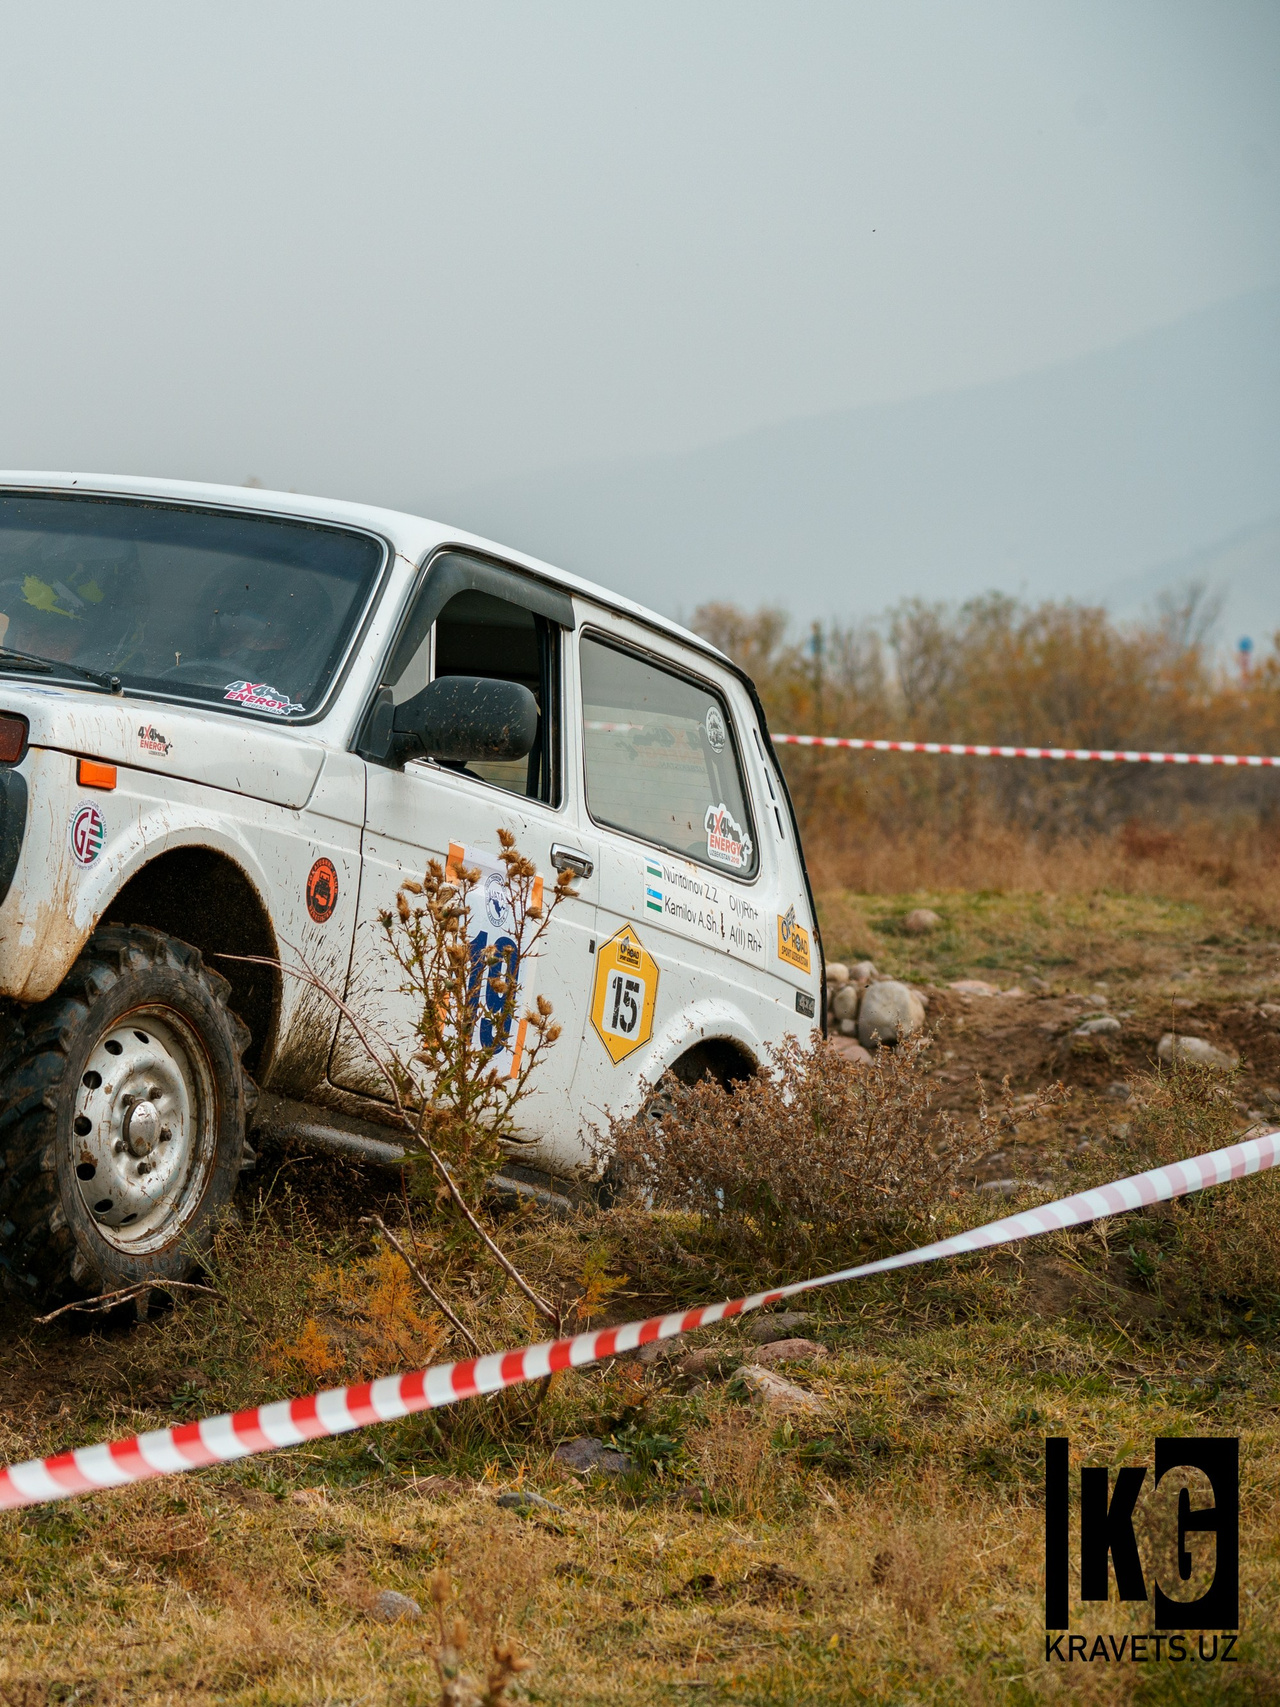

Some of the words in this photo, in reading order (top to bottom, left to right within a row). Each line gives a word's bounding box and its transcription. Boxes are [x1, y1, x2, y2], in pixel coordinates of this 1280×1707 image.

[226, 691, 287, 710] ENERGY
[140, 739, 166, 752] ENERGY
[710, 834, 742, 857] ENERGY
[664, 895, 697, 924] Kamilov
[791, 933, 808, 955] ROAD
[466, 930, 520, 1056] 19
[612, 976, 640, 1034] 15
